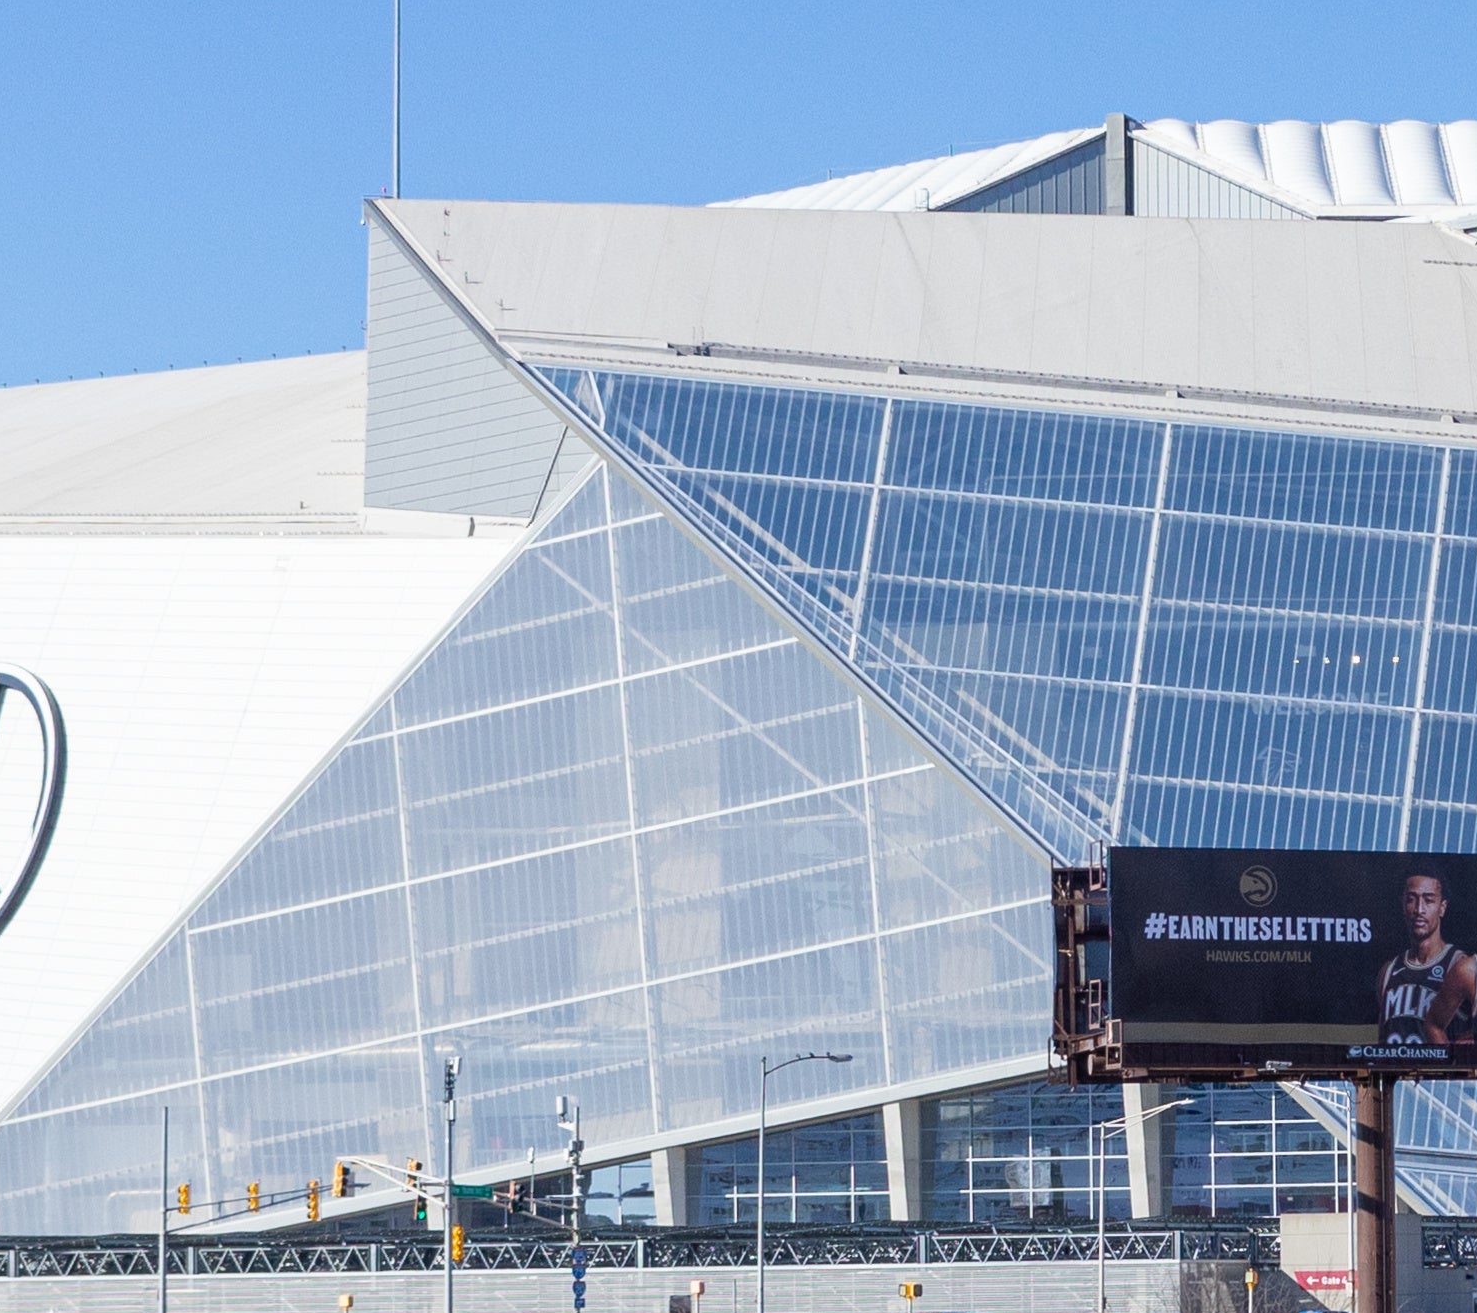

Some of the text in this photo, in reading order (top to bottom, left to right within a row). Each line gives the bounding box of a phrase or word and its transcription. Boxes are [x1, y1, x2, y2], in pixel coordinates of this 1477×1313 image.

[1144, 912, 1372, 942] #EARNTHESELETTERS
[1206, 950, 1312, 963] HAWKS.COM/MLK
[1384, 983, 1438, 1022] MLK
[1321, 1275, 1340, 1285] Gate
